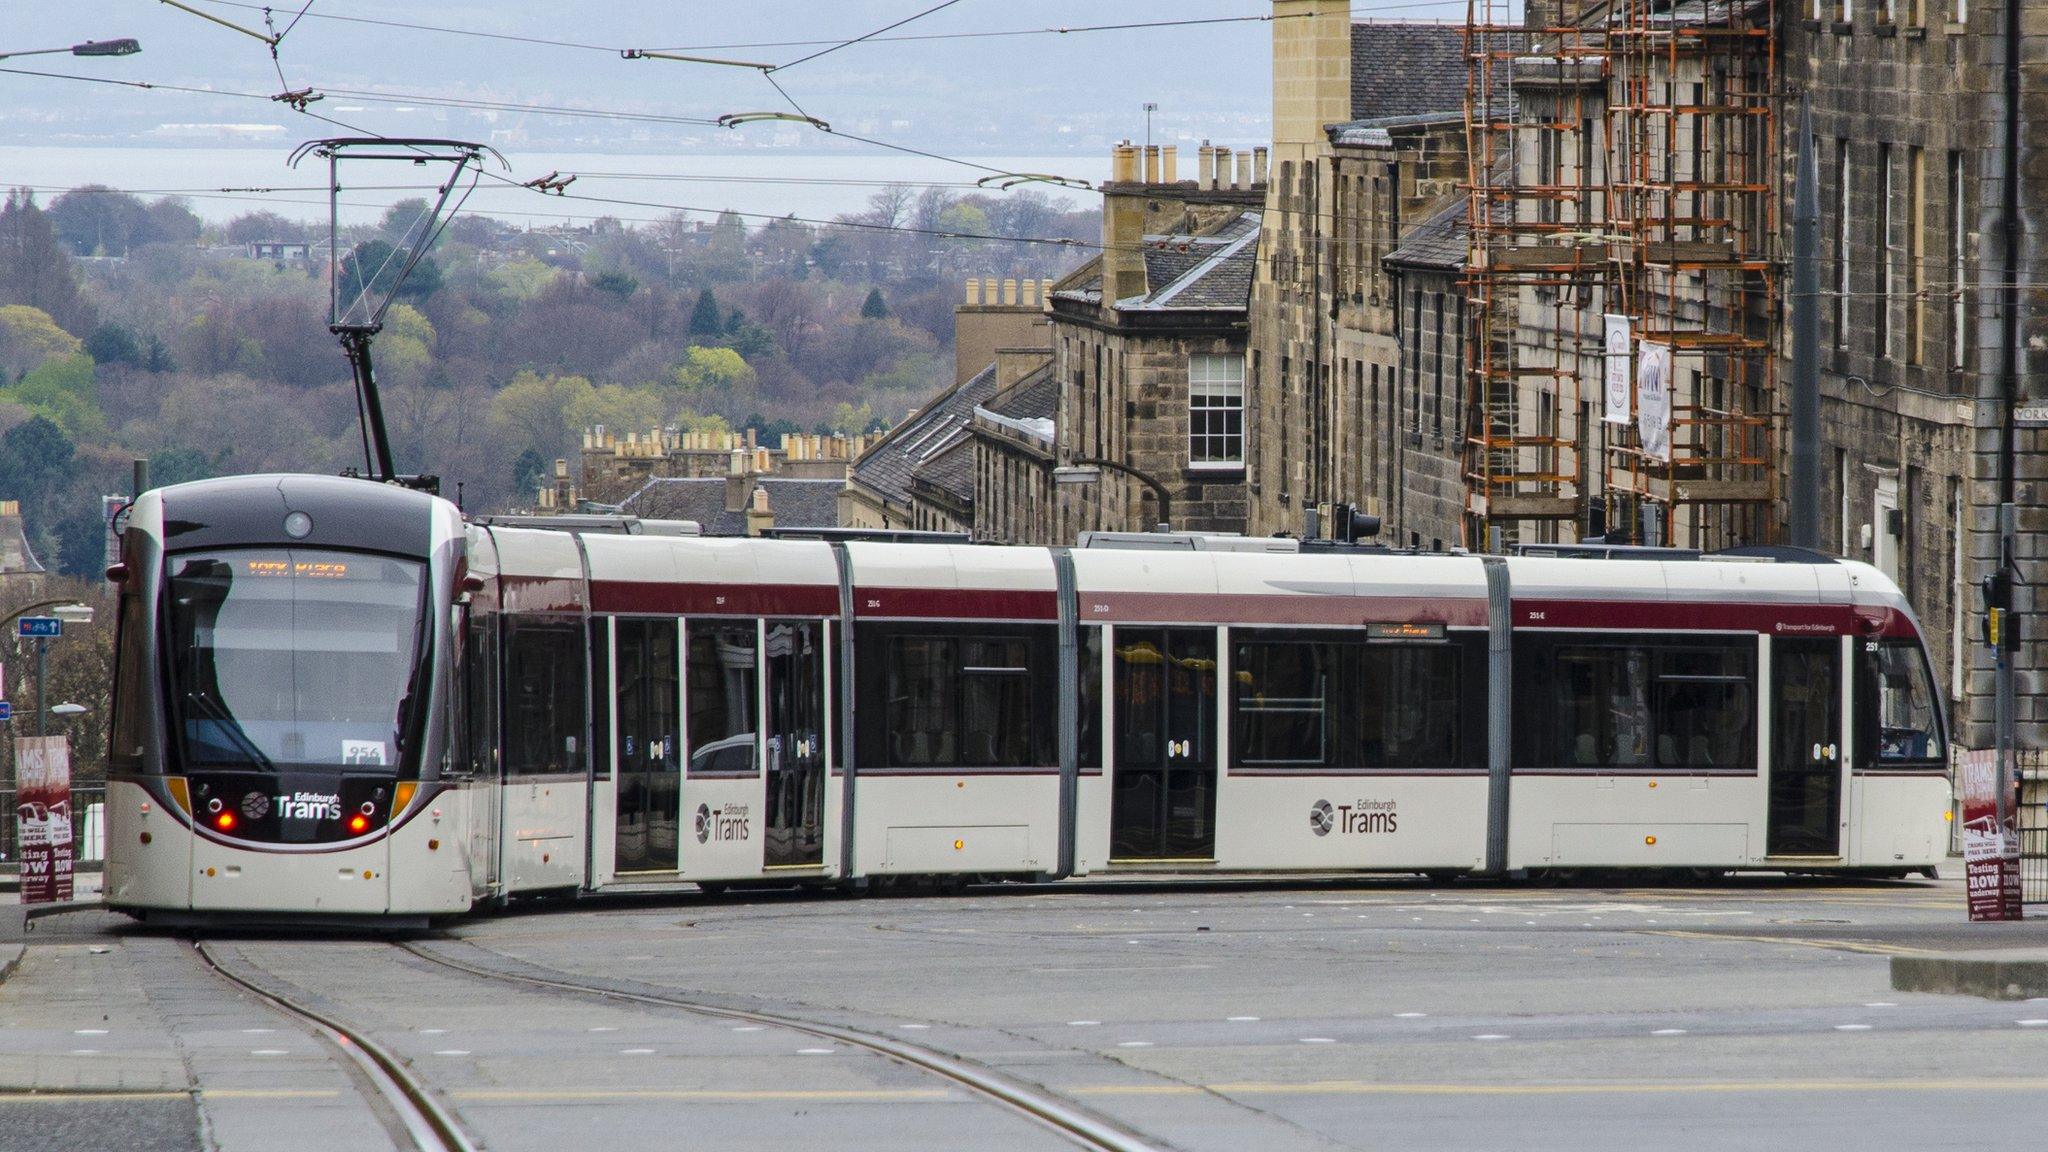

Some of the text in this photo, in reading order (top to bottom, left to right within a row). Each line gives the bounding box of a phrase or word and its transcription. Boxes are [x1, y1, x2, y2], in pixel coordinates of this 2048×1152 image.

[1866, 641, 1878, 651] 251
[350, 746, 380, 760] 956
[295, 792, 339, 804] Edinburgh
[273, 796, 341, 820] Trams
[725, 803, 748, 817] Edinburgh
[1357, 799, 1396, 812] Edinburgh
[713, 810, 749, 841] Trams
[1338, 805, 1397, 833] Trams
[1968, 862, 1998, 874] Testing
[1969, 874, 1999, 889] now
[1969, 889, 2000, 898] underway
